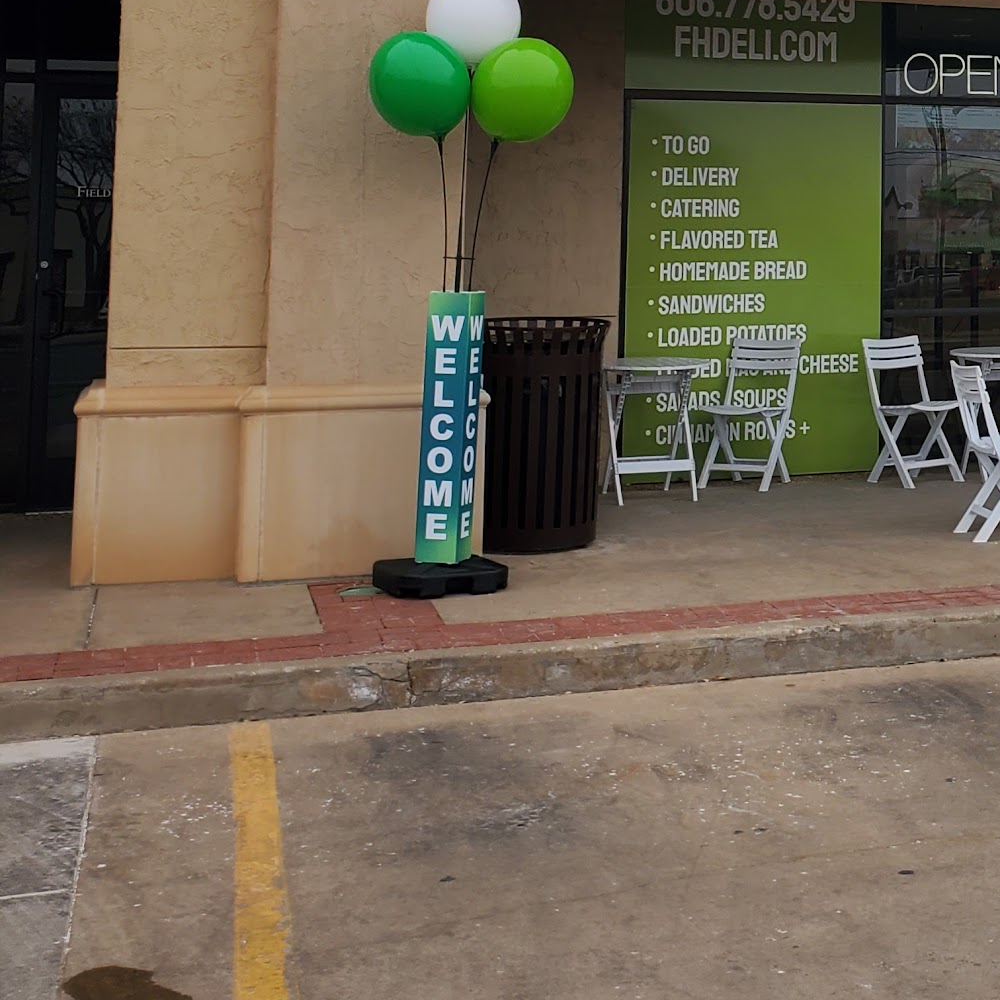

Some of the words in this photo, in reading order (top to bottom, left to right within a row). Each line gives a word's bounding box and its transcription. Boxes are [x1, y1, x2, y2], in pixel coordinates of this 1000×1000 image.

[674, 25, 838, 63] FHDELI.COM
[661, 135, 684, 155] TO
[687, 136, 710, 155] GO
[661, 167, 740, 187] DELIVERY
[660, 198, 741, 218] CATERING
[660, 230, 745, 249] FLAVORED
[747, 229, 778, 249] TEA
[659, 262, 750, 282] HOMEMADE
[753, 260, 807, 280] BREAD
[657, 293, 765, 315] SANDWICHES
[657, 326, 722, 348] LOADED
[726, 324, 808, 346] POTATOES
[798, 353, 859, 374] CHEESE
[733, 388, 788, 408] SOUPS
[423, 315, 465, 541] WELCOME
[460, 314, 484, 540] WELCOME
